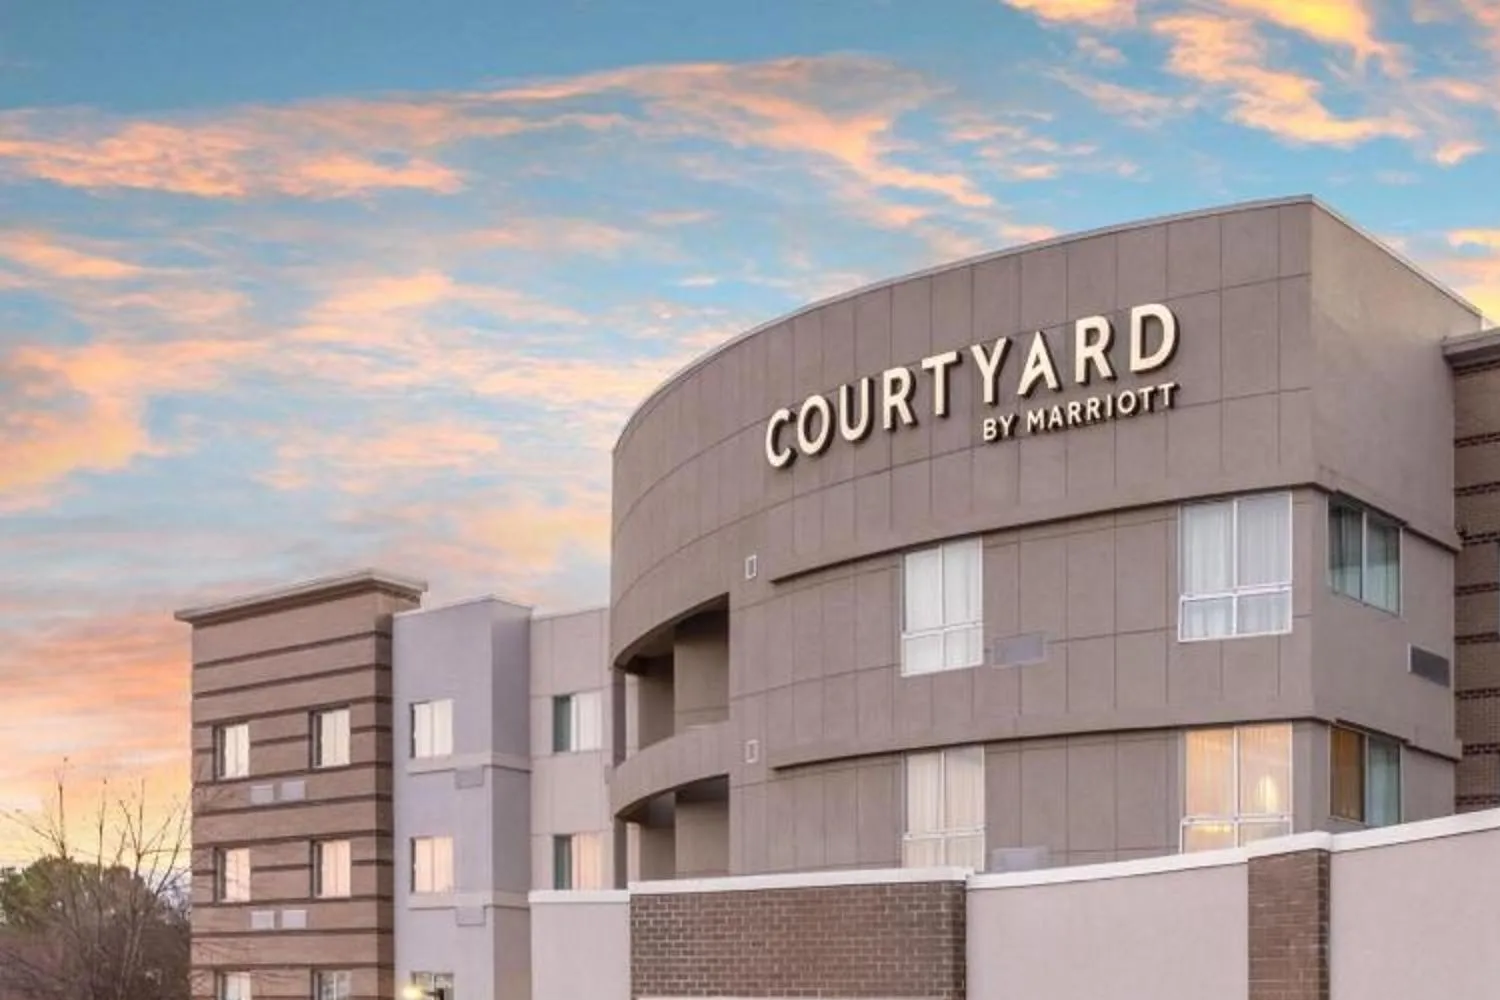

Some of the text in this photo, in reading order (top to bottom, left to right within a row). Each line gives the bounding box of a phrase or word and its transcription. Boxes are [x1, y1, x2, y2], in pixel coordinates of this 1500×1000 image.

[765, 303, 1179, 467] COURTYARD
[983, 382, 1180, 442] BY MARRIOTT
